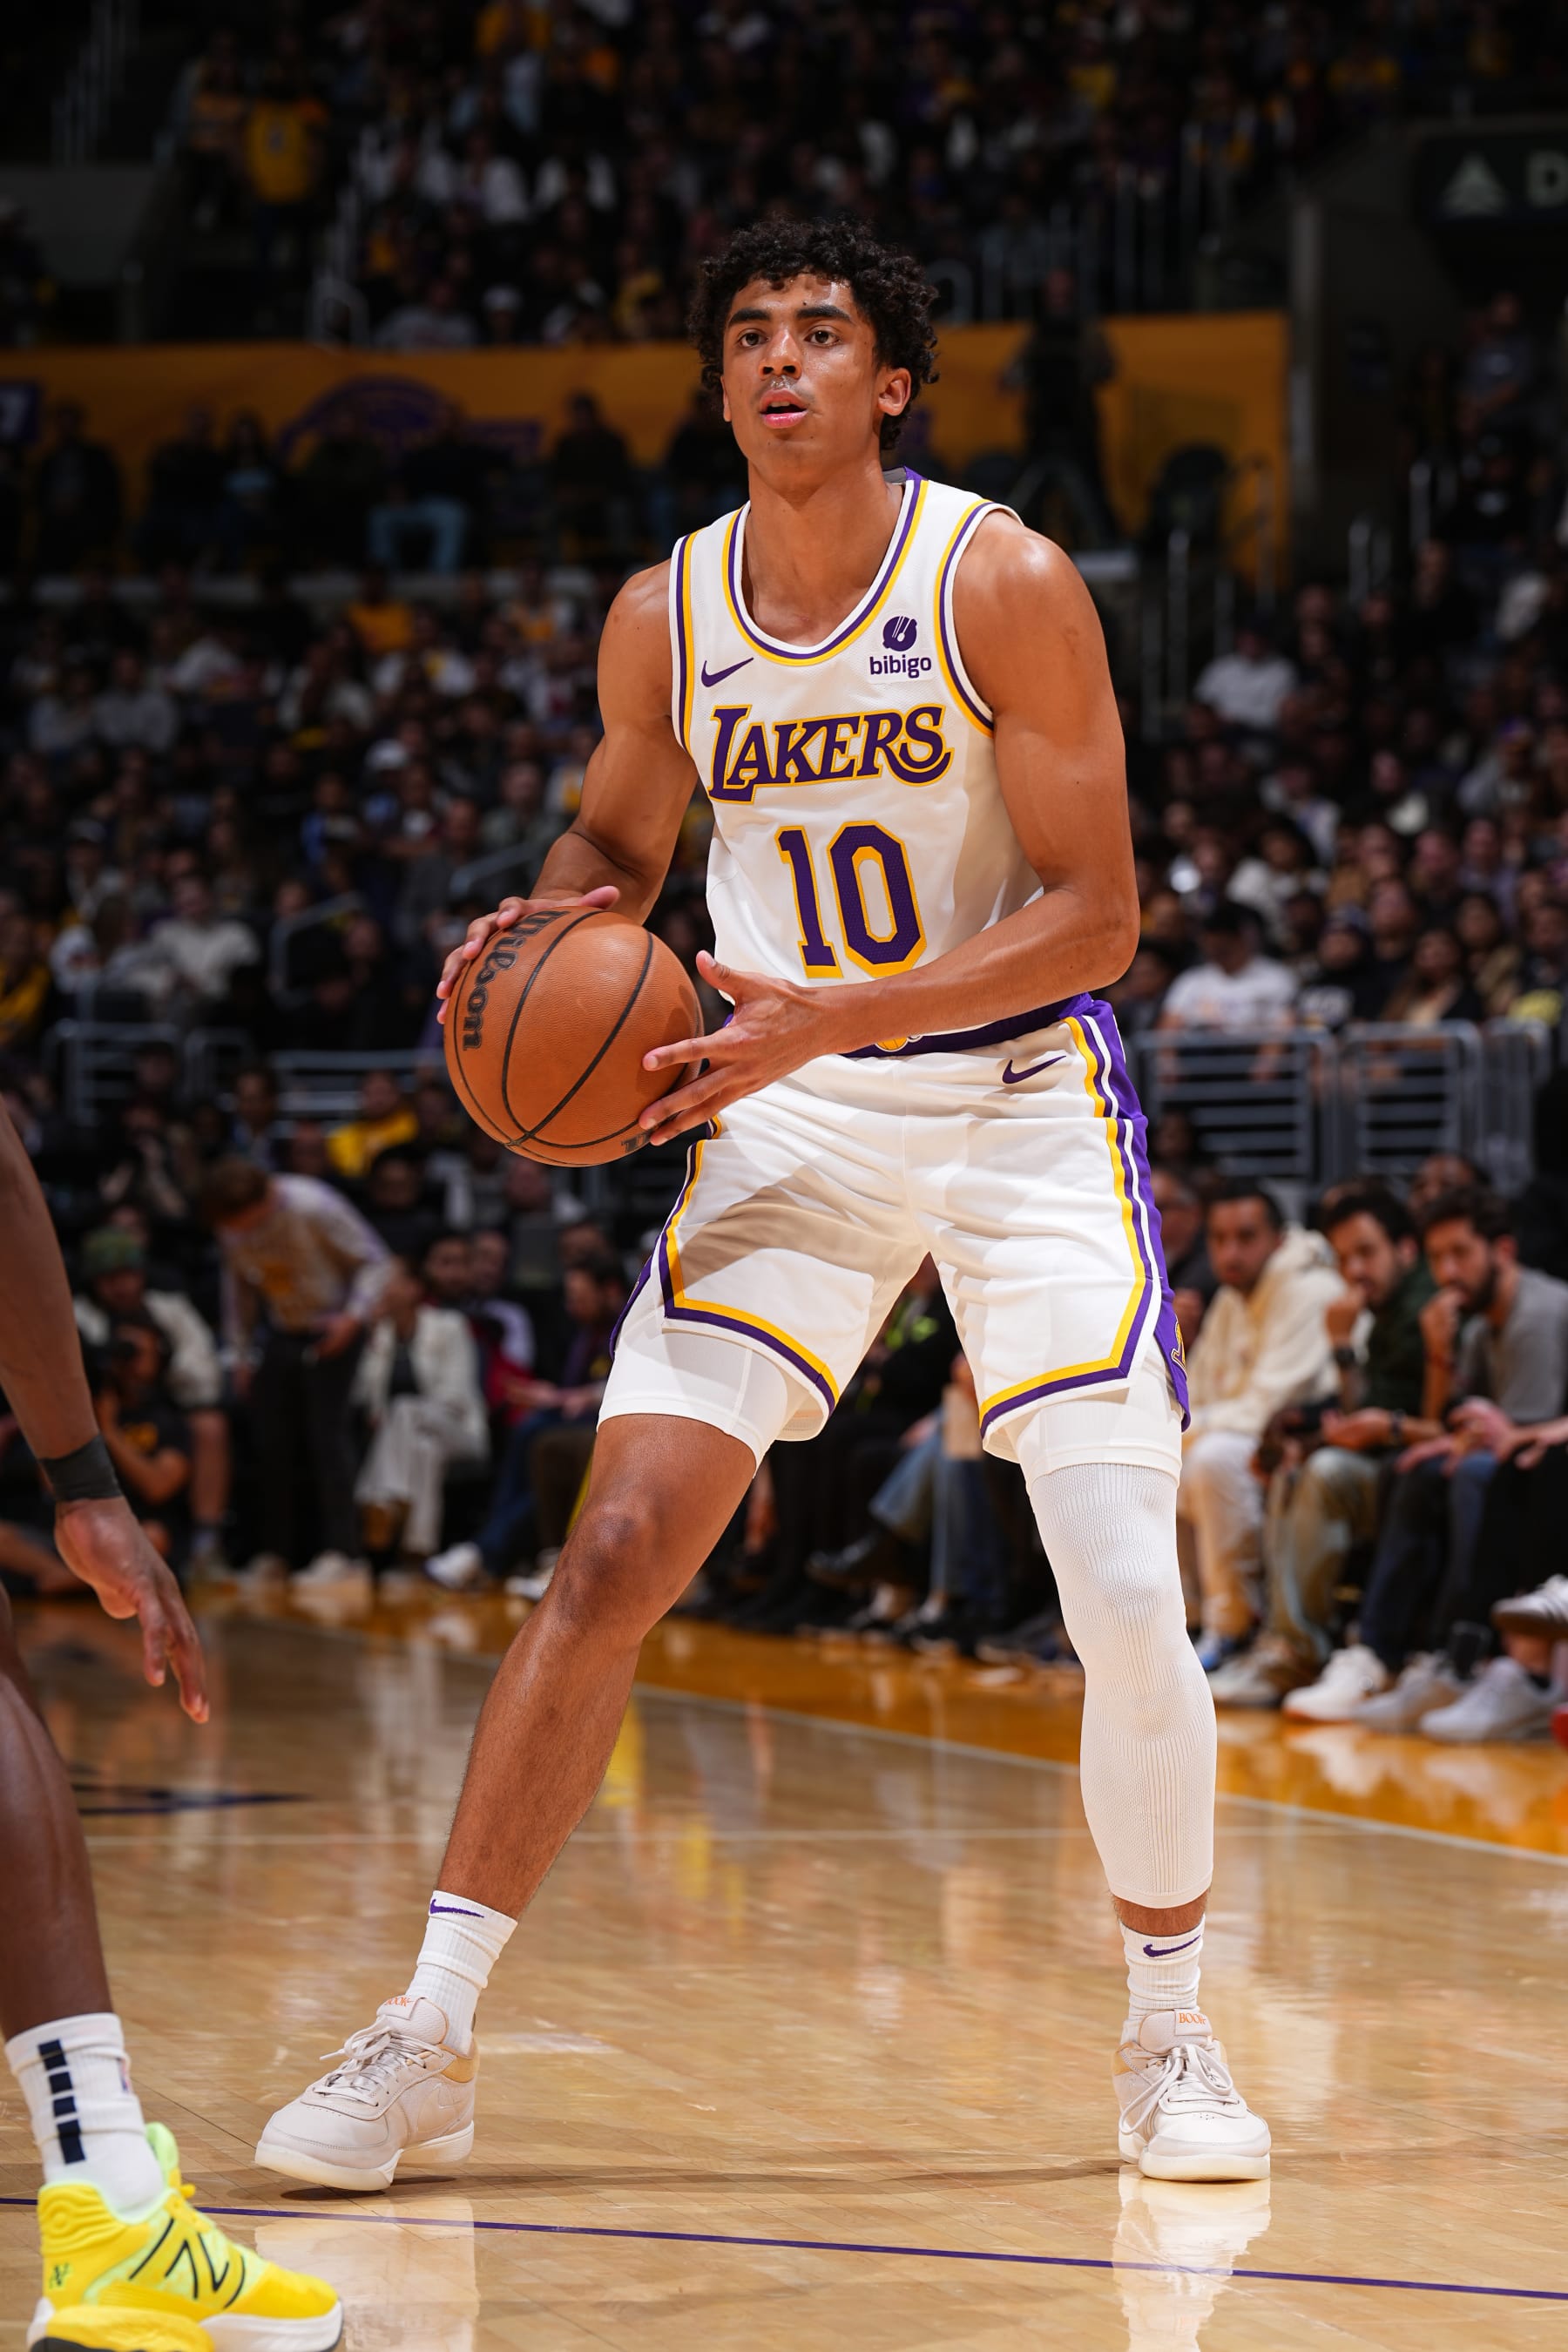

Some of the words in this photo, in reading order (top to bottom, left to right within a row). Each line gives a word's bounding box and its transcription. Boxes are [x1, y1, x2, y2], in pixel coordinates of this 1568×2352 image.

[869, 654, 932, 679] bibigo
[709, 704, 955, 803] LAKERS
[774, 821, 927, 979] 10
[463, 910, 571, 1051] Wilson
